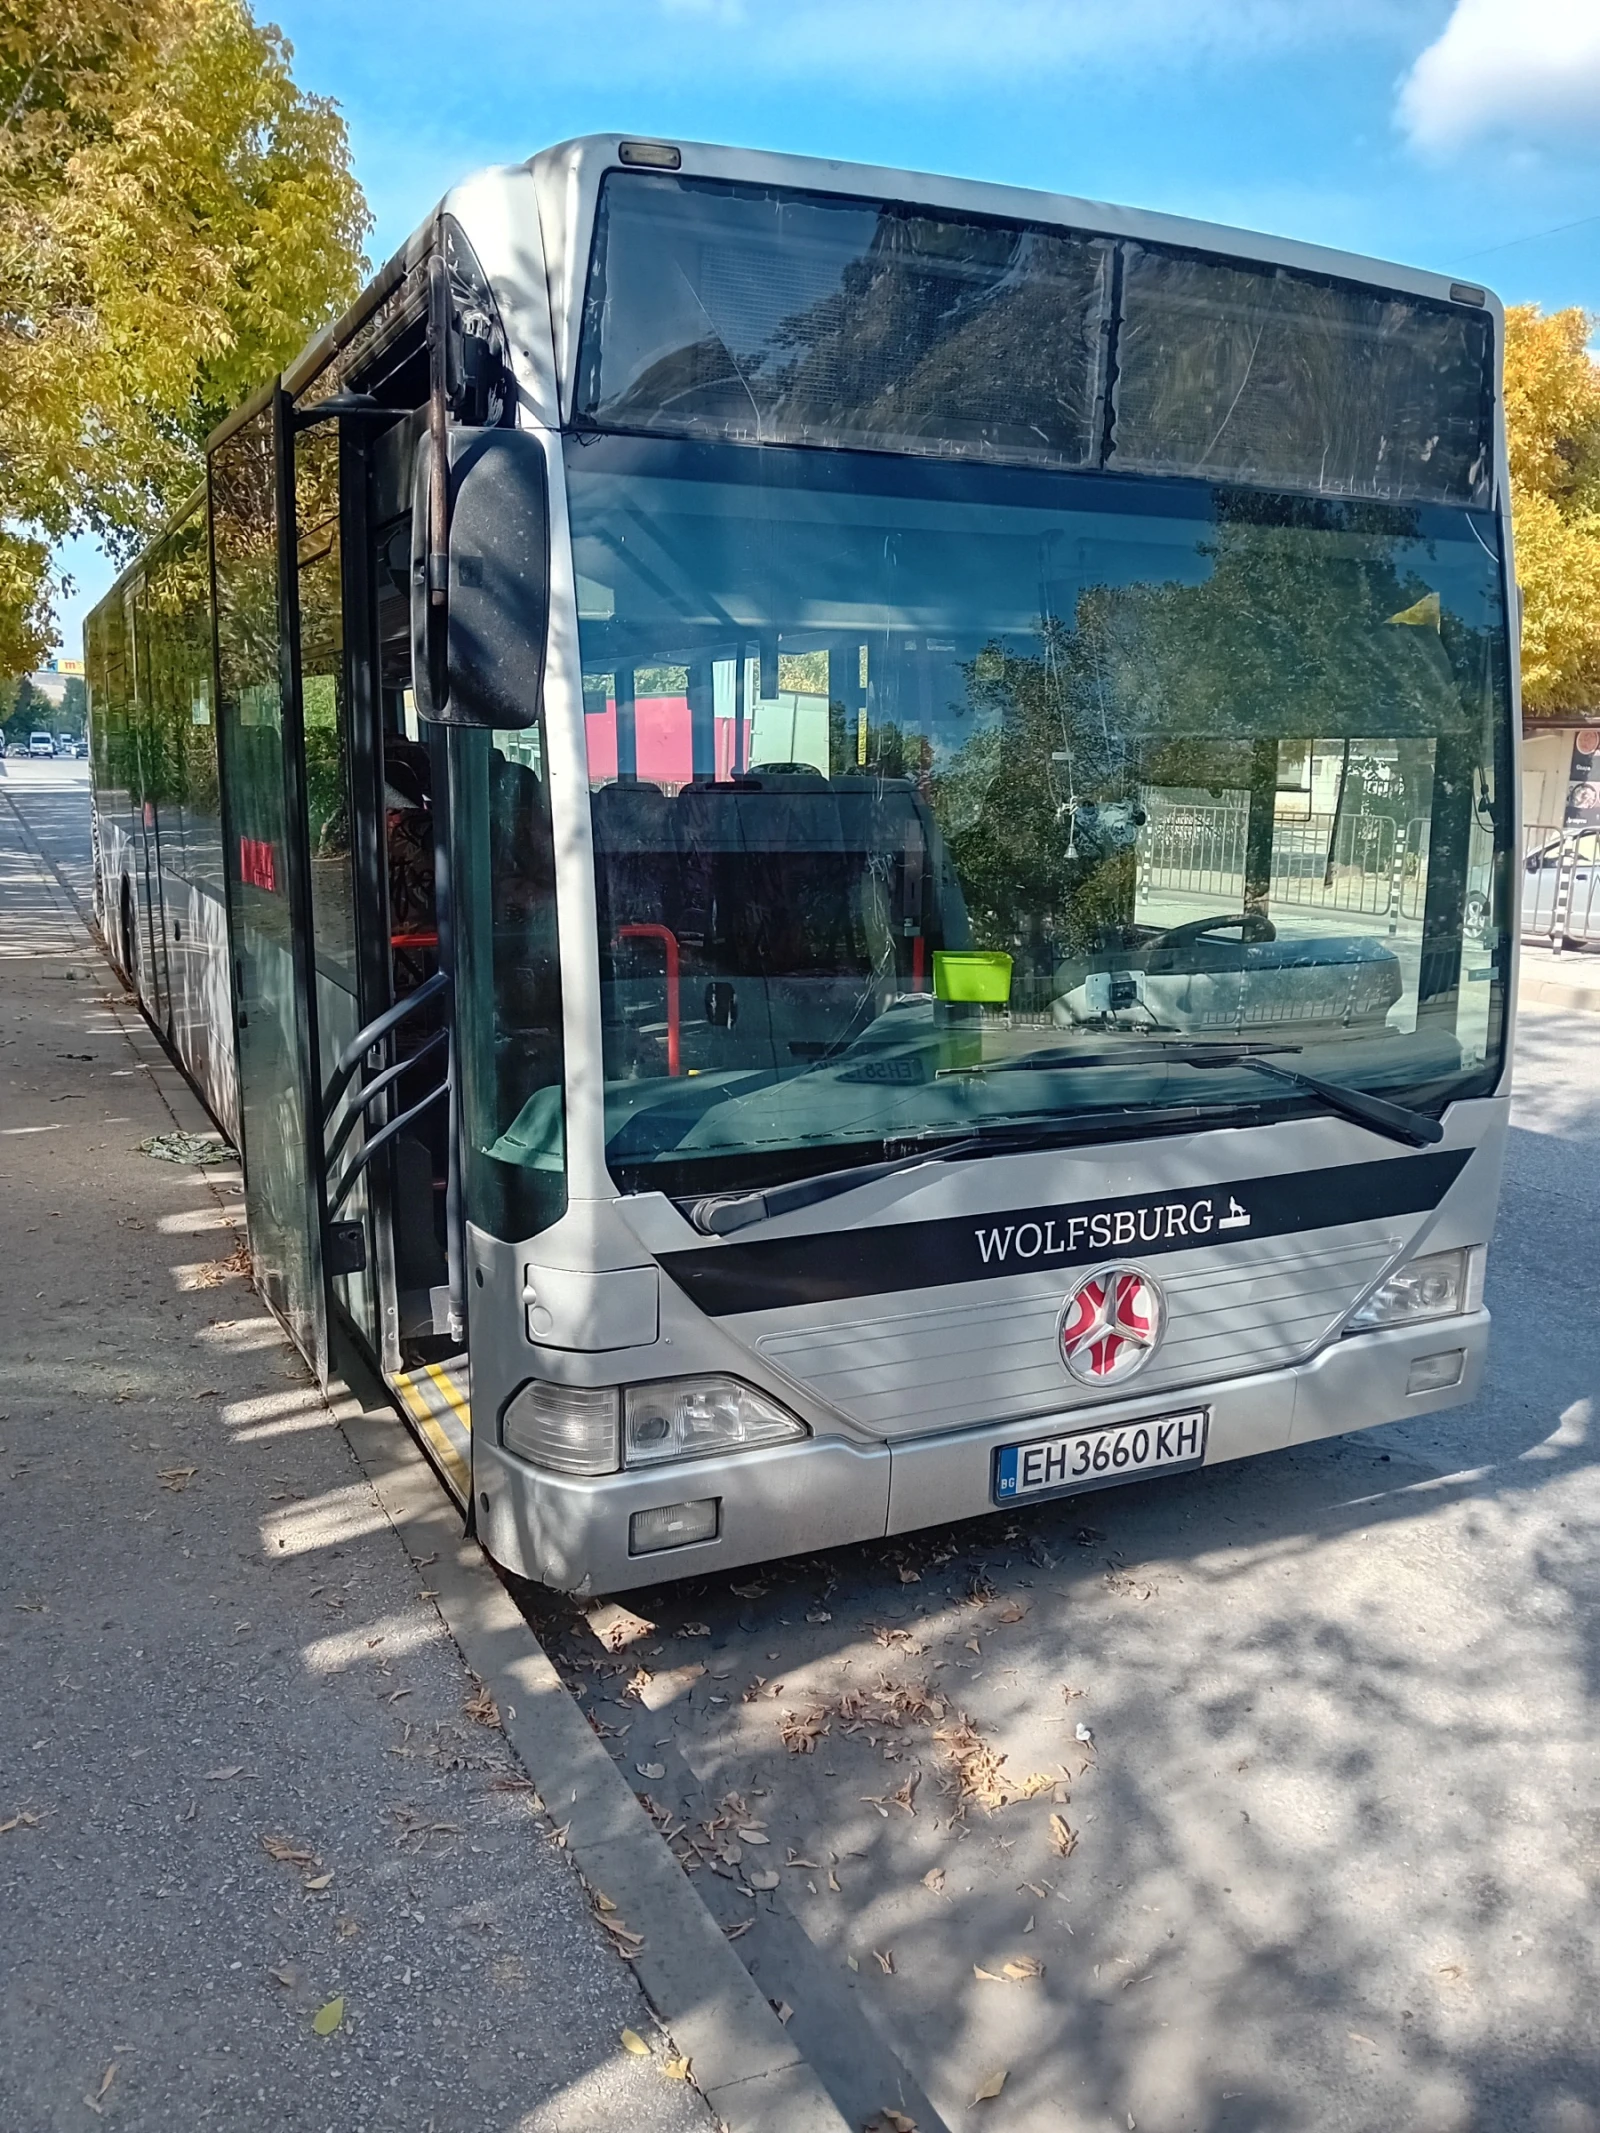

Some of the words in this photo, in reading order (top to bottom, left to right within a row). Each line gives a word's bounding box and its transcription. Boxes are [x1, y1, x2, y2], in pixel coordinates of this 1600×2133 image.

[974, 1200, 1214, 1263] WOLFSBURG
[1000, 1477, 1015, 1490] BG
[1022, 1444, 1067, 1487] EH
[1071, 1429, 1150, 1476] 3660
[1155, 1419, 1199, 1460] KH
